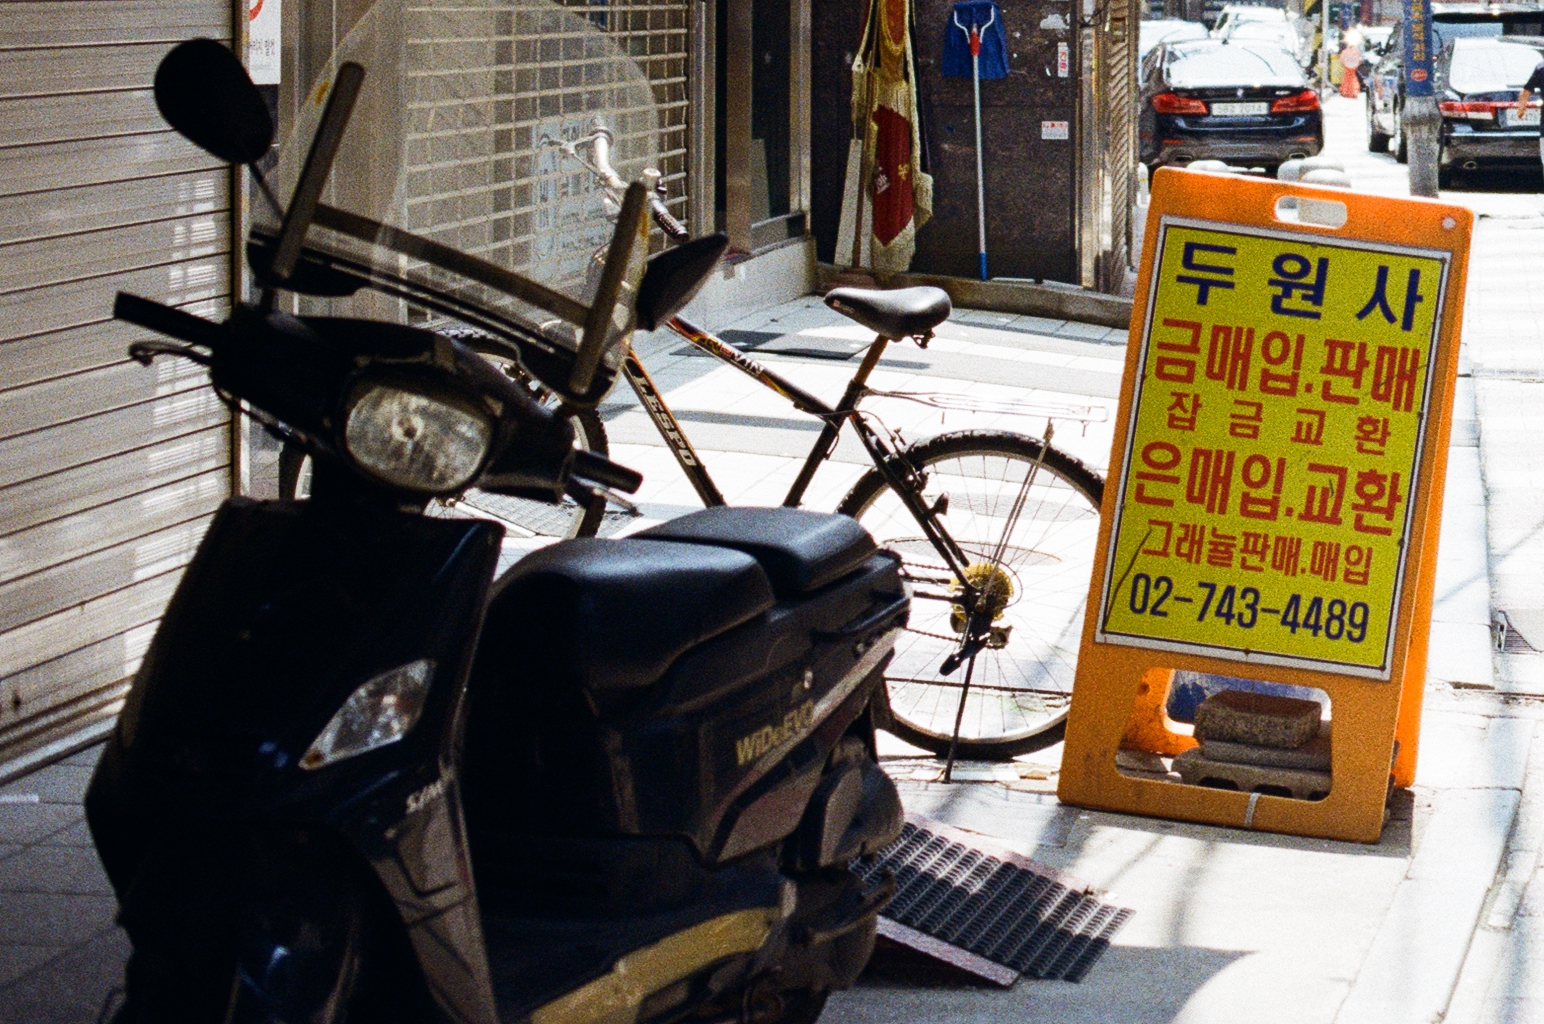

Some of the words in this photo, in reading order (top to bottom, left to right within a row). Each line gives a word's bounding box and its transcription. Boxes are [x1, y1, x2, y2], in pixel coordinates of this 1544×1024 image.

[1175, 241, 1424, 332] 두원사
[1154, 317, 1421, 414] 금매입.판매
[1134, 441, 1403, 537] 은매입.교환
[1129, 572, 1370, 643] 02-743-4489
